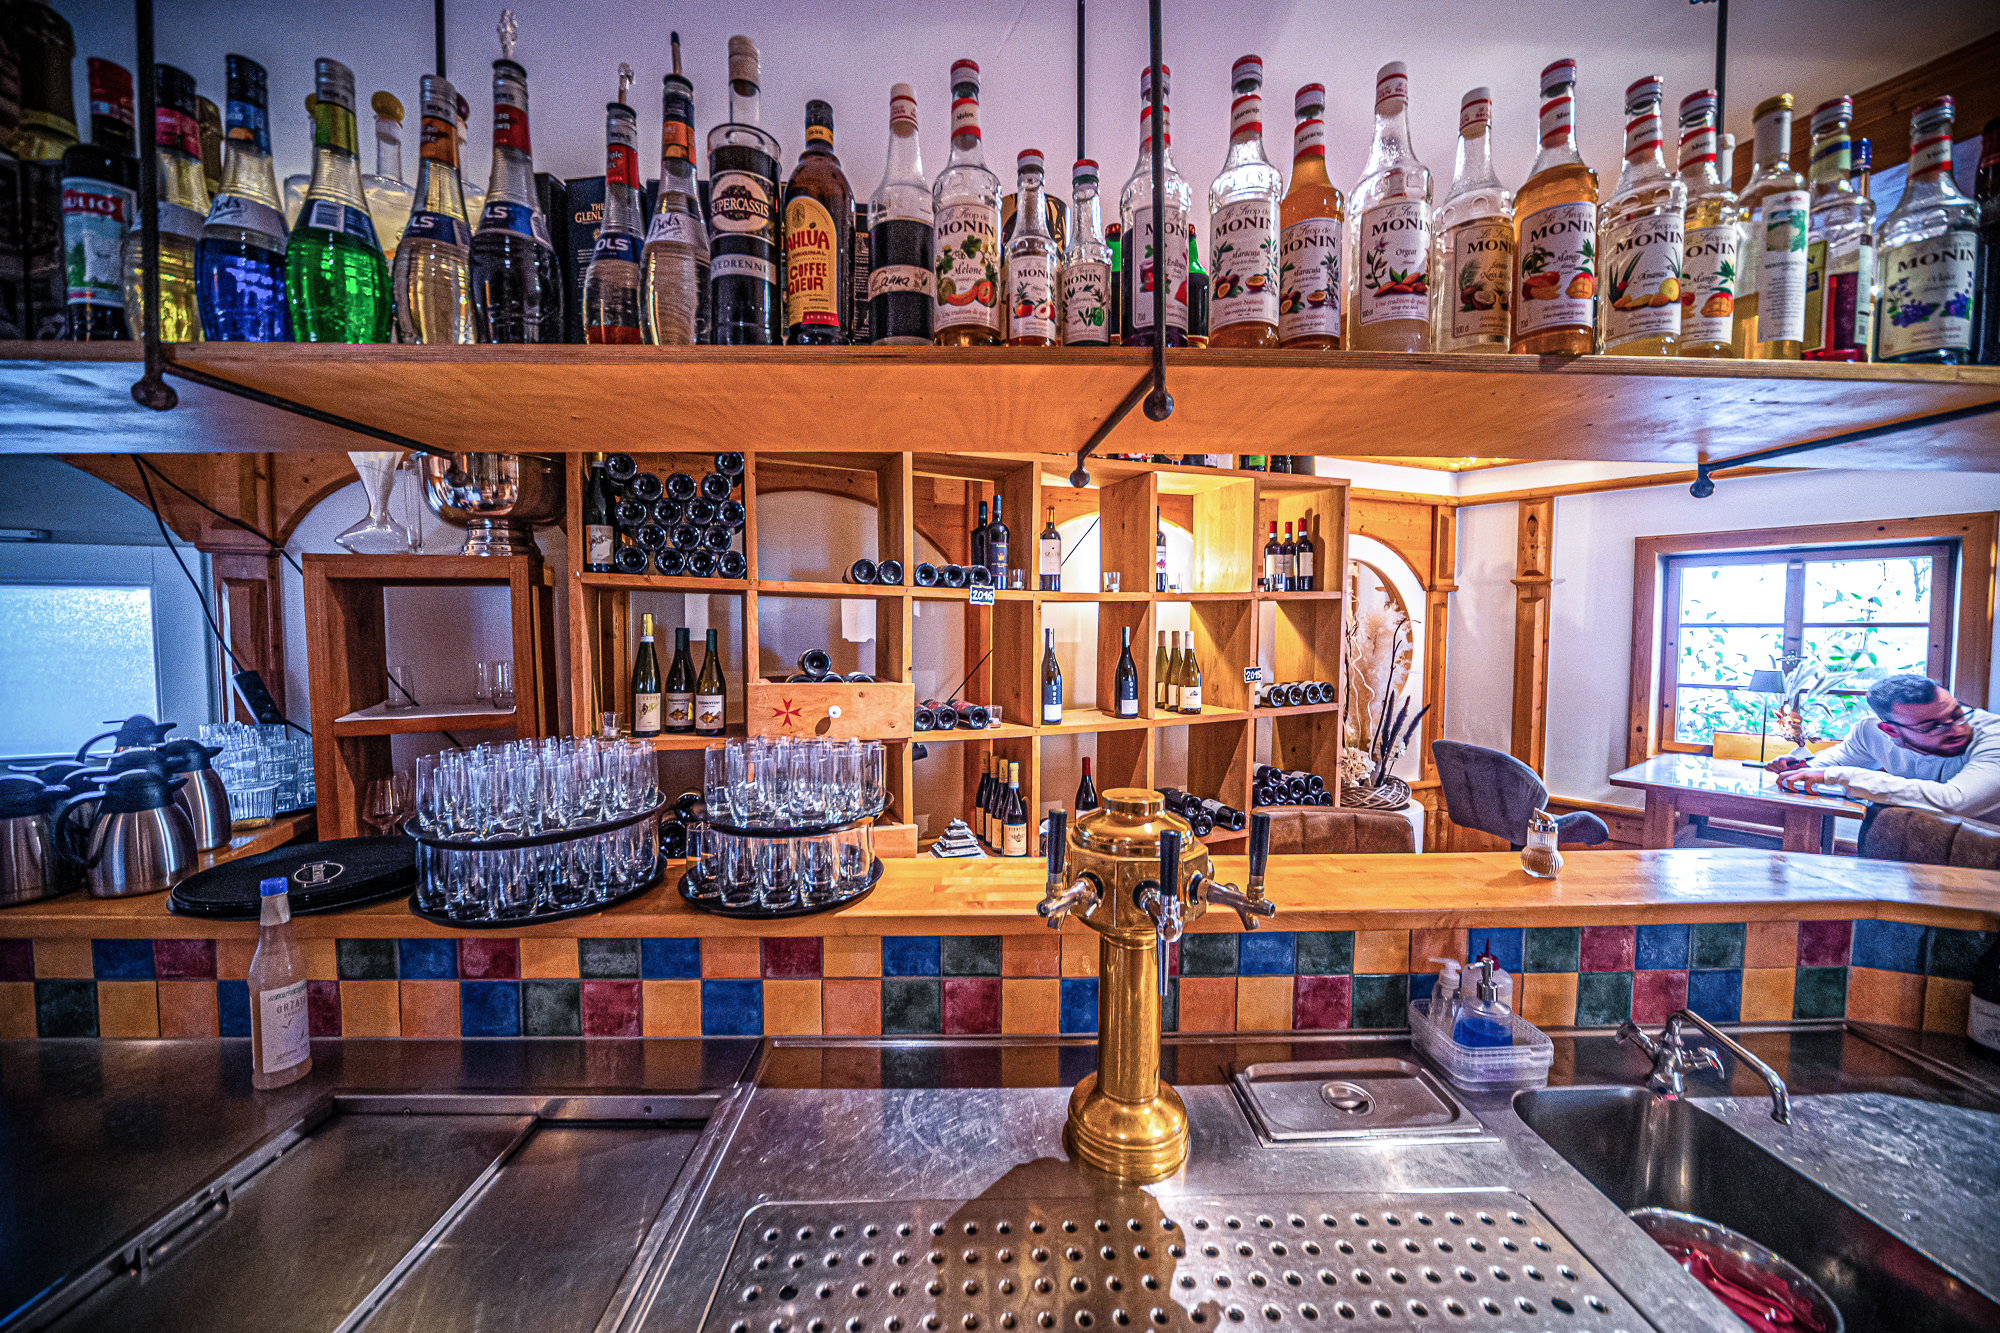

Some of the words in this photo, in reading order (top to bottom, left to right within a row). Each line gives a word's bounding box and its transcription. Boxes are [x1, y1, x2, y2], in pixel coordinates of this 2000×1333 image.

[412, 215, 435, 228] LS
[485, 206, 509, 219] LS
[575, 211, 603, 223] GLENL
[938, 220, 995, 240] MONIN
[1216, 216, 1271, 240] MONIN
[1372, 218, 1433, 237] MONIN
[1531, 220, 1594, 242] MONIN
[596, 237, 629, 251] OLS
[787, 230, 830, 251] AHLUA
[1280, 235, 1336, 257] MONIN
[1467, 239, 1512, 254] MONI
[1616, 231, 1683, 255] MONIN
[1685, 242, 1735, 258] ONIN
[1897, 248, 1975, 273] MONIN
[790, 262, 827, 280] COFFEE
[788, 276, 824, 296] QUEUR
[972, 588, 993, 601] 2016
